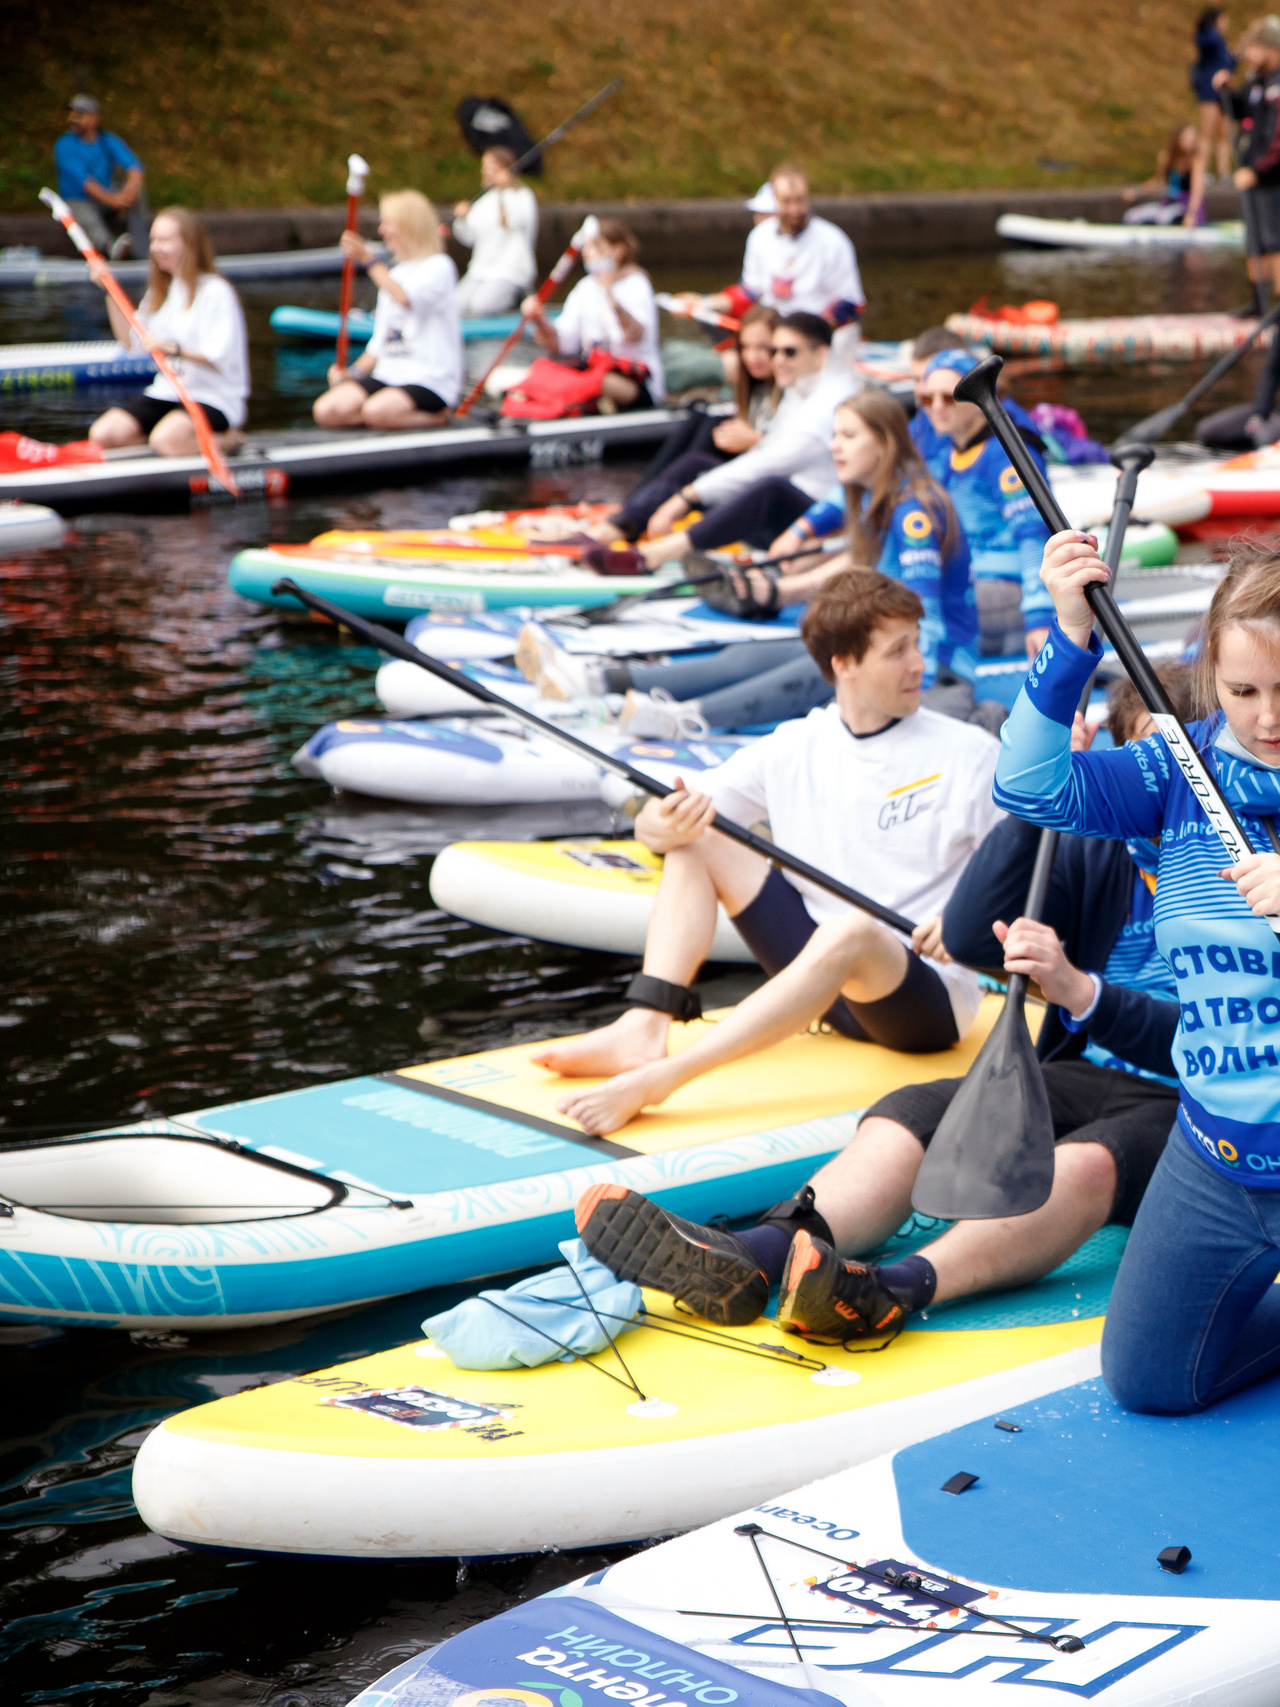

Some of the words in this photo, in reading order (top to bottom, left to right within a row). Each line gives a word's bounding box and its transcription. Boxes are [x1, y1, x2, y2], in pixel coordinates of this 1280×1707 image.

[1161, 728, 1241, 864] RO-FORCE
[826, 1576, 940, 1621] 0344
[544, 1625, 739, 1705] онлайн
